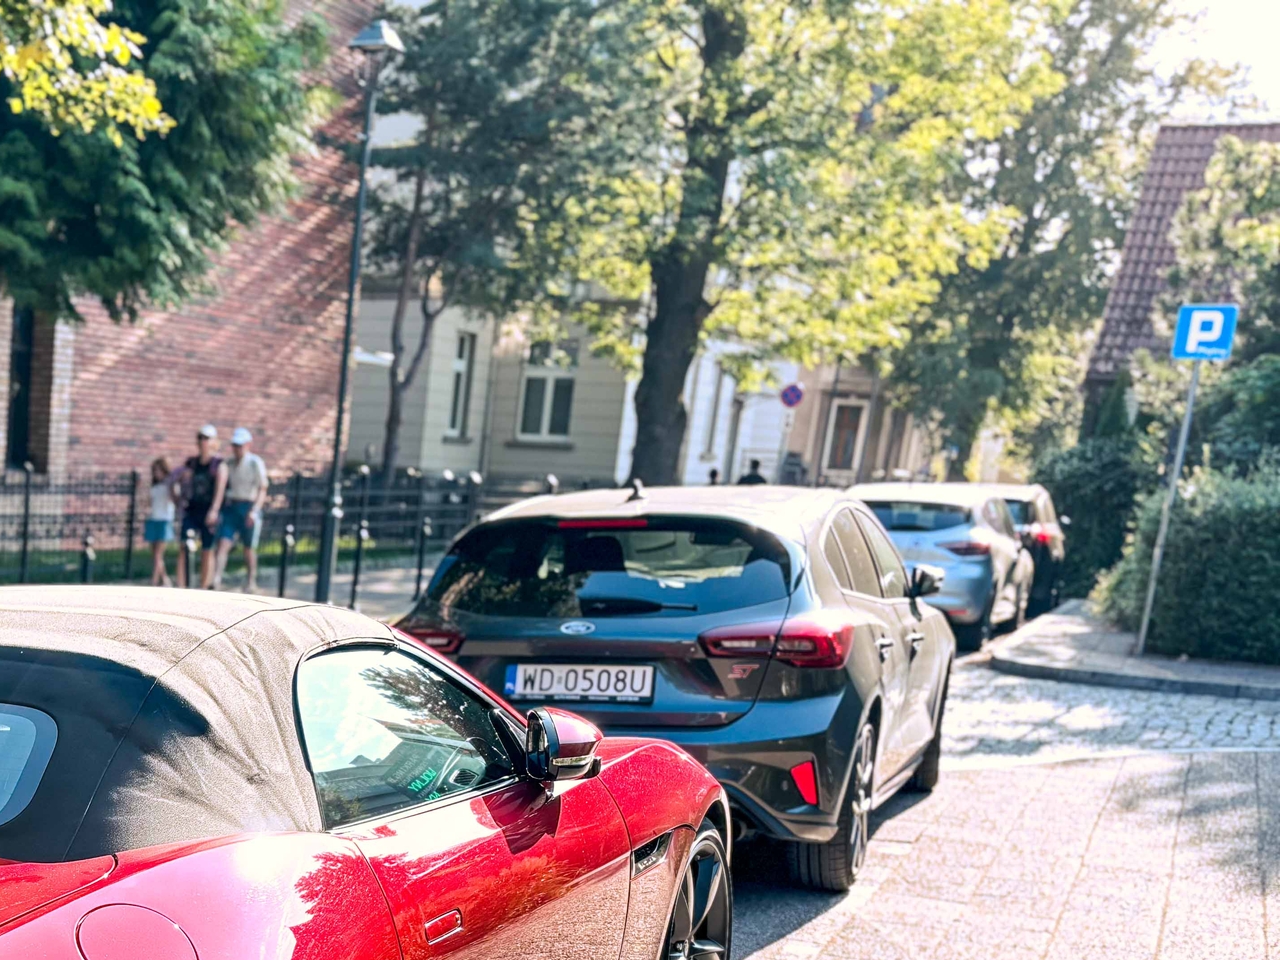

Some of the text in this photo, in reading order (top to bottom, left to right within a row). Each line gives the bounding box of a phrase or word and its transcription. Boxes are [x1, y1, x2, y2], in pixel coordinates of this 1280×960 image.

[1185, 310, 1224, 353] P
[523, 667, 647, 694] WD 0508U
[727, 664, 760, 679] ST
